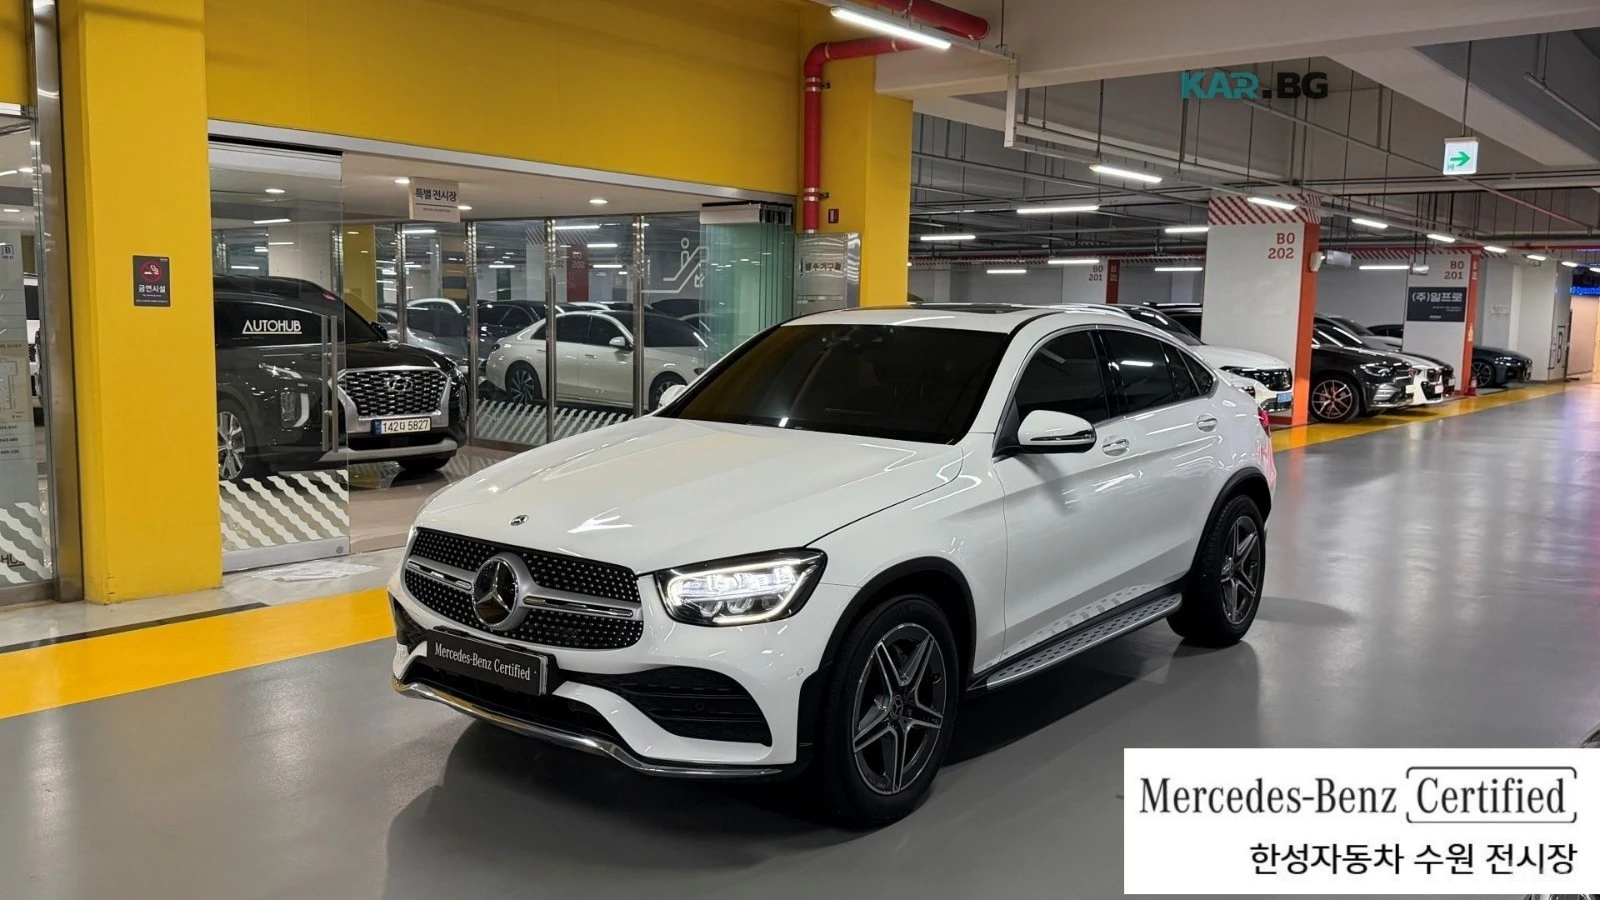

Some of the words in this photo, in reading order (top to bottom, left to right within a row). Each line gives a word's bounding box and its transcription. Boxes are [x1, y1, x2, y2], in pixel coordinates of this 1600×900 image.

[415, 187, 432, 199] 특별
[432, 189, 457, 202] 전시장
[1268, 247, 1294, 259] 202
[1088, 273, 1102, 281] 201
[1444, 270, 1463, 280] 201
[138, 284, 166, 293] 금연시설
[242, 319, 302, 334] AUTOHUB
[407, 419, 429, 431] 5827
[434, 642, 492, 670] Mercedes-Benz
[493, 658, 531, 681] Certified
